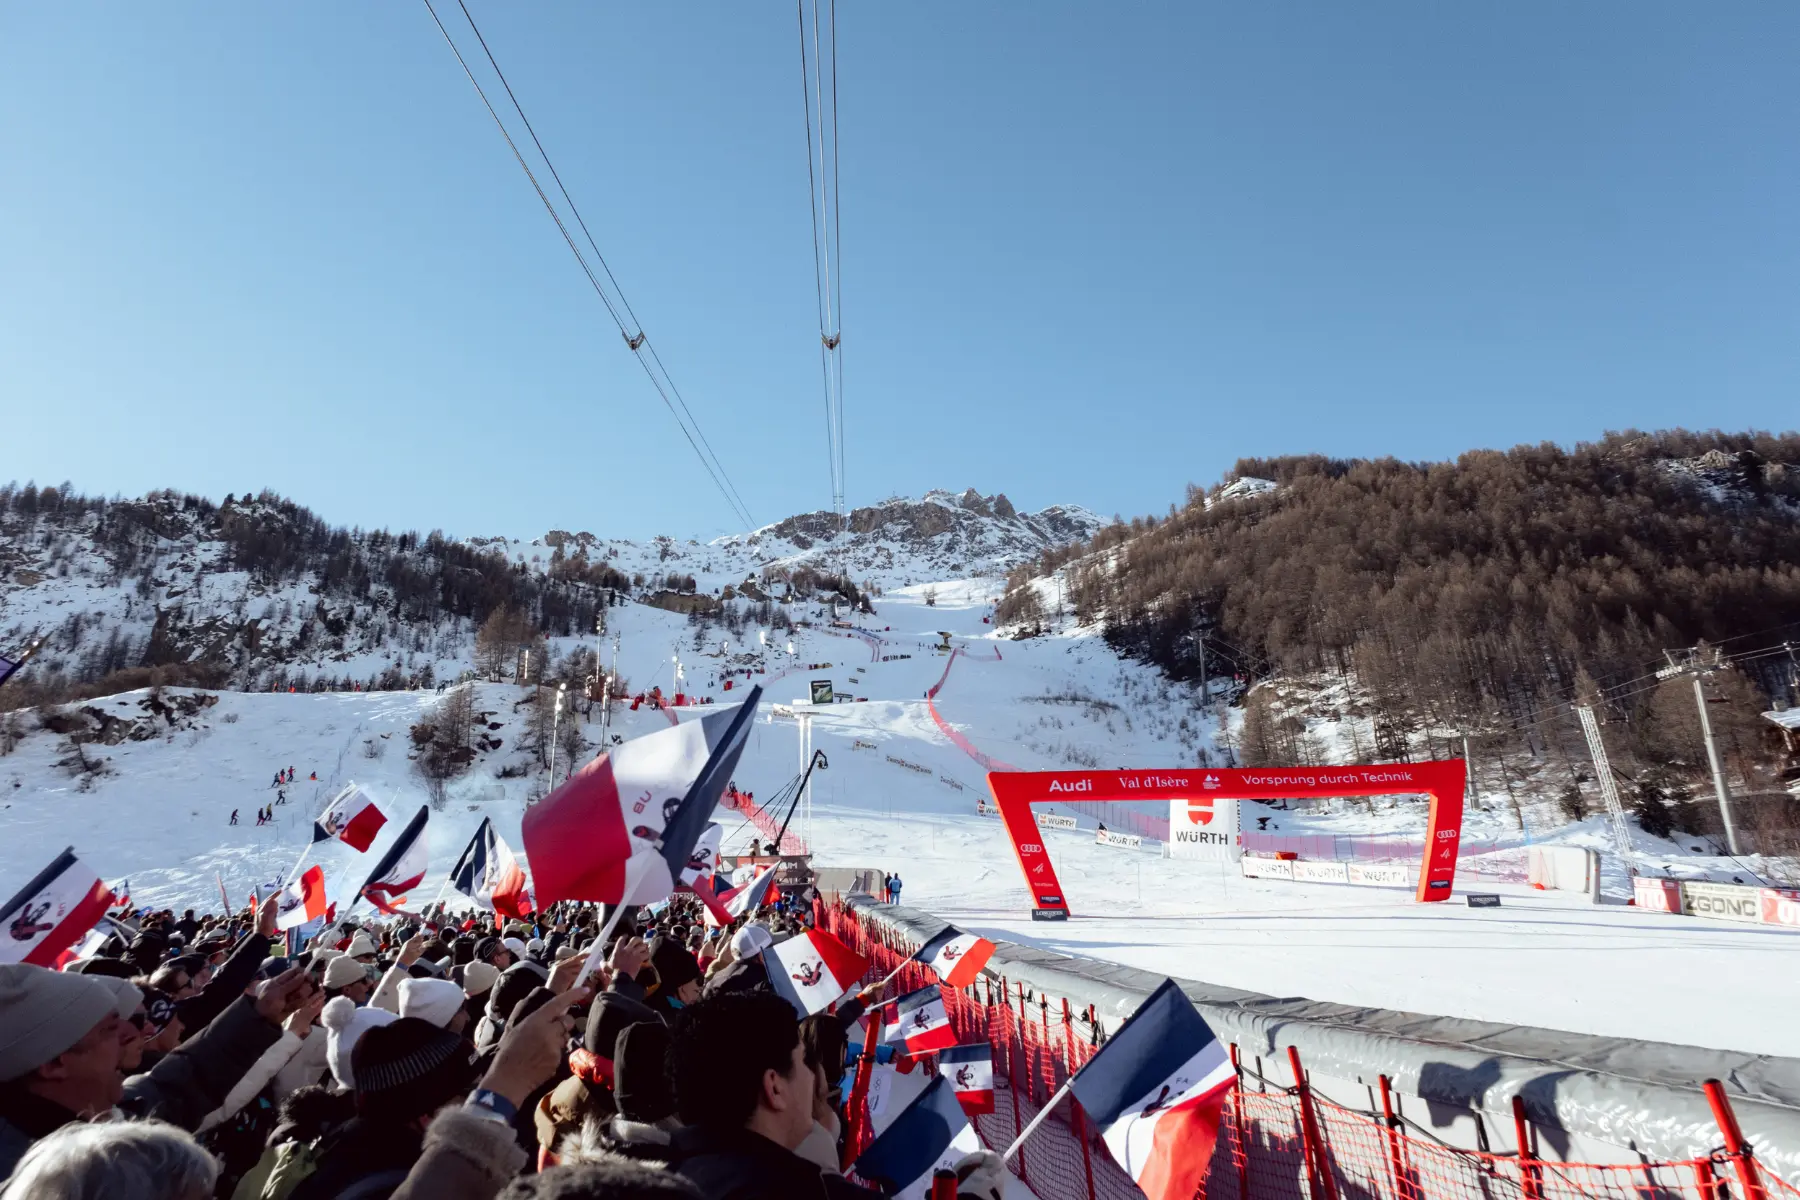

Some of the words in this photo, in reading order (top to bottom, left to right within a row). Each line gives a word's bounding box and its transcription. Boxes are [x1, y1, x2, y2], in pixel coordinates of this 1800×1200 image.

[1049, 779, 1092, 792] Audi
[1119, 777, 1140, 788] Val
[1143, 776, 1189, 788] d'Isère
[1242, 775, 1315, 787] Vorsprung
[1319, 773, 1359, 784] durch
[1361, 771, 1413, 782] Technik
[1176, 830, 1228, 845] WÜRTH
[1684, 893, 1756, 917] ZGONC
